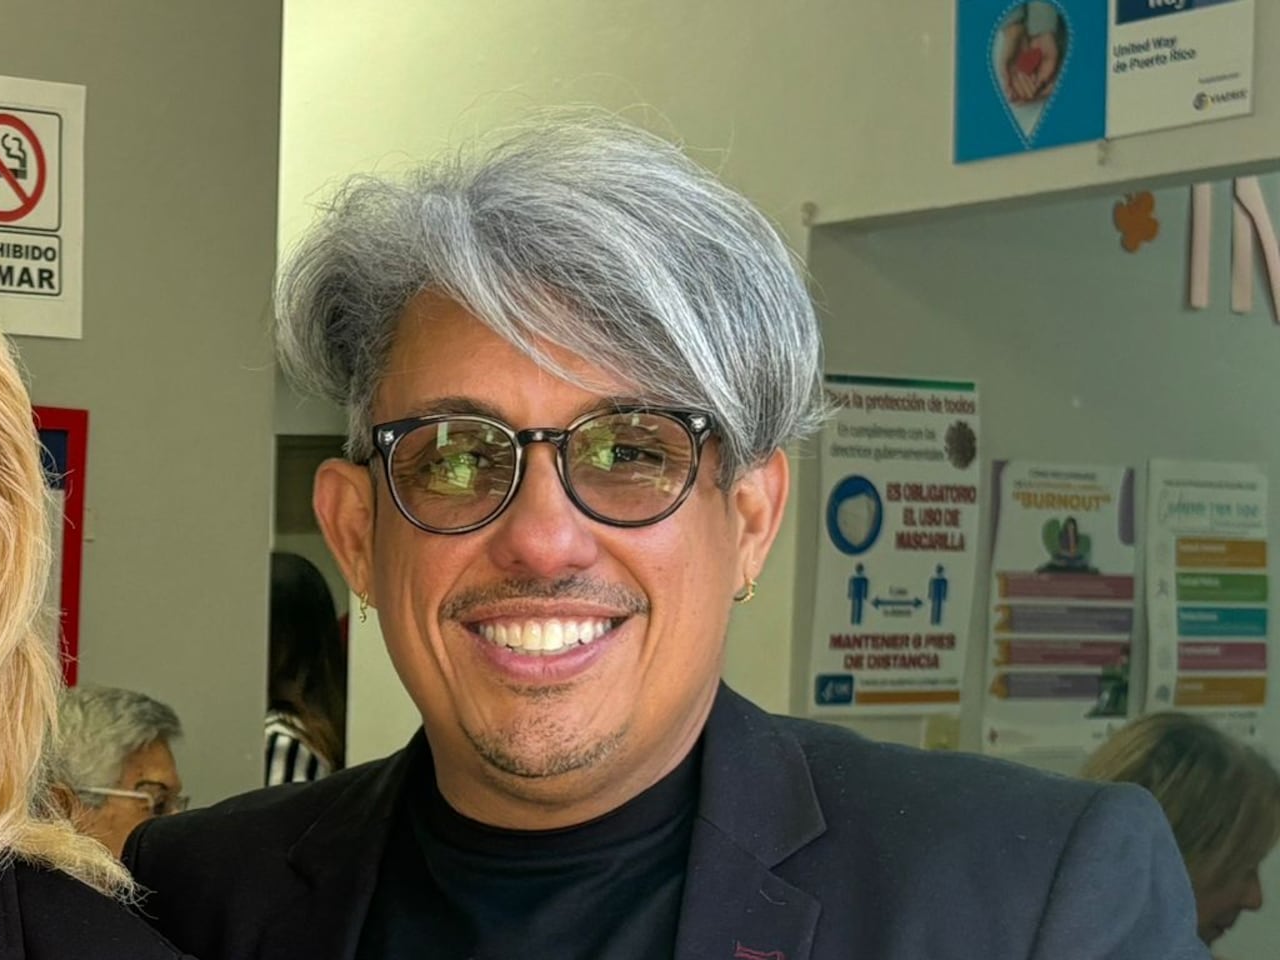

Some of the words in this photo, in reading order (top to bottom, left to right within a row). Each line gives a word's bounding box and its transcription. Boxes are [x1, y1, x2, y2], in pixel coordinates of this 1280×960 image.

[1113, 38, 1150, 57] United
[1152, 35, 1177, 50] Way
[1113, 59, 1127, 73] de
[1129, 54, 1167, 70] Puerto
[1170, 48, 1196, 62] Rico
[864, 393, 926, 414] protección
[927, 394, 942, 413] de
[943, 396, 976, 415] todos
[886, 482, 901, 502] ES
[903, 483, 977, 503] OBLIGATORIO
[903, 508, 917, 527] EL
[919, 508, 942, 527] USO
[944, 509, 960, 528] DE
[895, 532, 965, 552] MASCARILLA
[830, 633, 911, 651] MANTENER
[924, 633, 956, 651] PIES
[843, 654, 864, 669] DE
[866, 654, 939, 669] DISTANCIA
